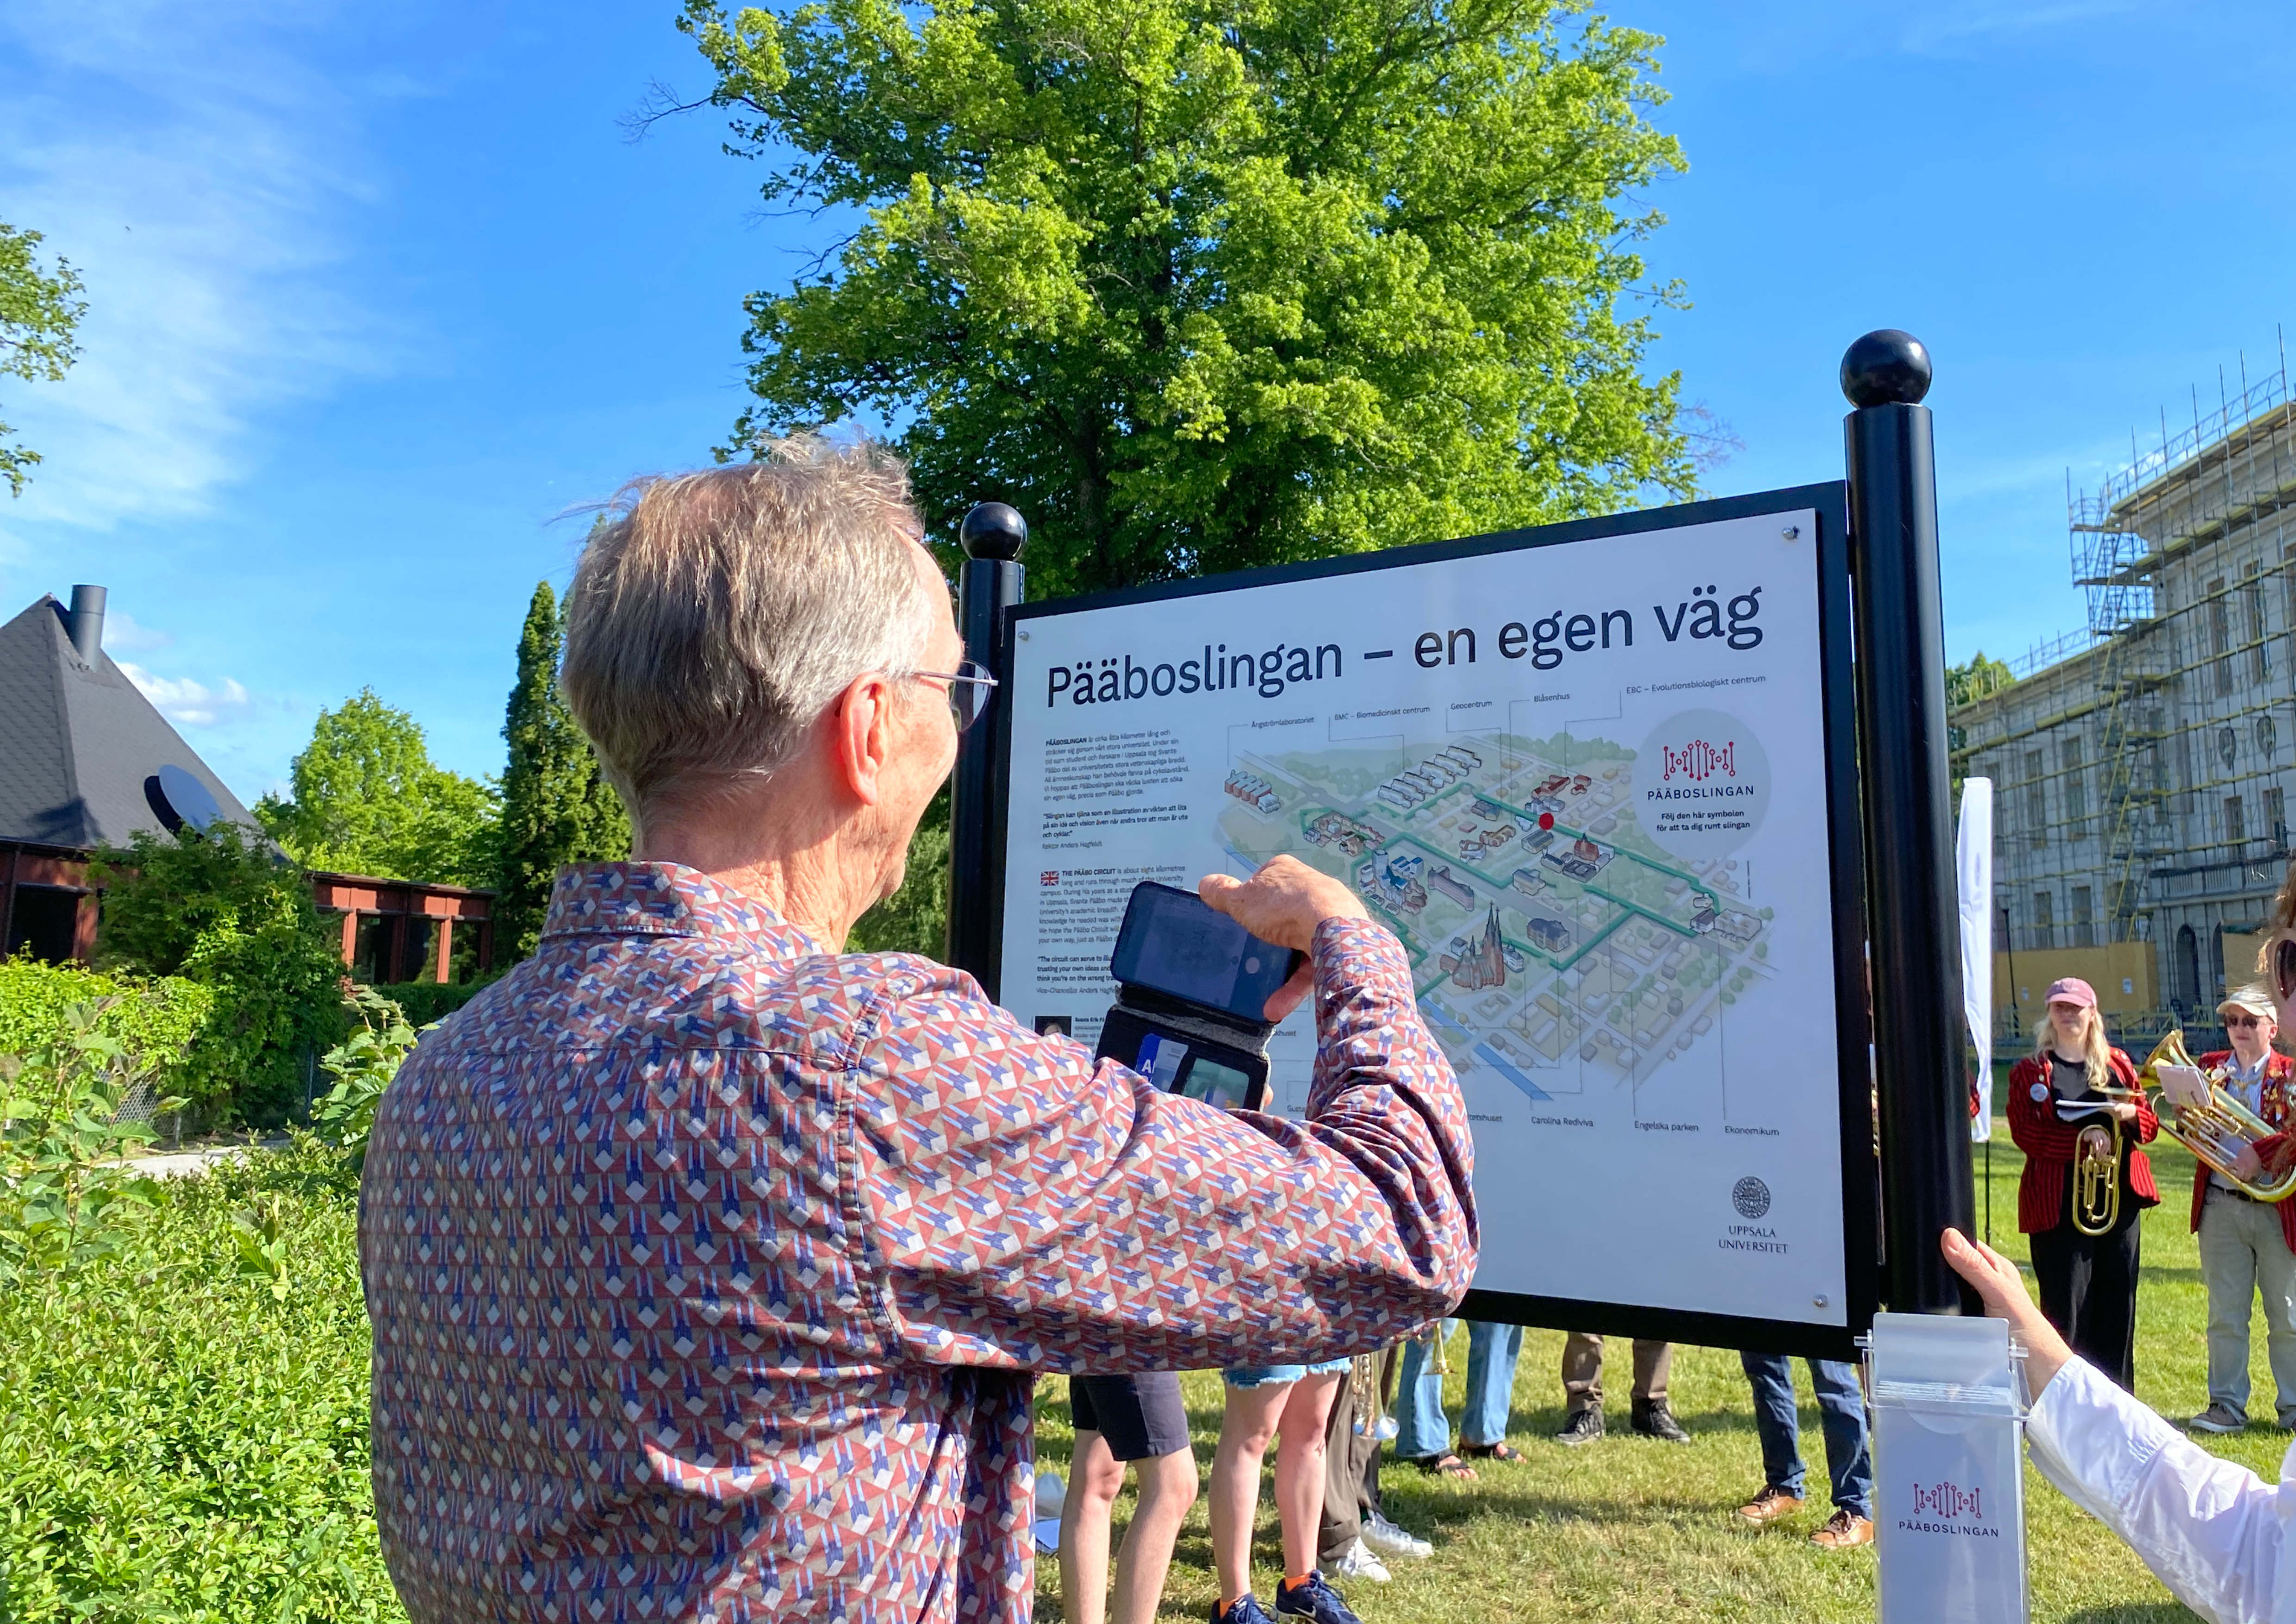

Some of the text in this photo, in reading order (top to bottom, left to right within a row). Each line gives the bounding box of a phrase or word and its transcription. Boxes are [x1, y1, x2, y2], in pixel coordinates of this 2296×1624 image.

[1048, 643, 1342, 708] Pääboslingan
[1414, 628, 1476, 668] en
[1499, 610, 1633, 670] egen
[1653, 585, 1763, 650] väg
[1626, 686, 1642, 694] EBC
[1651, 678, 1730, 692] Evolutionsbiologiskt
[1731, 676, 1766, 685] centrum
[1534, 693, 1570, 702] Blåsenhus
[1450, 701, 1493, 710] Geocentrum
[1334, 712, 1349, 721] BMC
[1356, 708, 1401, 719] Biomedicinskt
[1251, 717, 1314, 730] Ångströmlaboratoriet
[1648, 785, 1754, 800] PÄÄBOSLINGAN
[1661, 812, 1675, 821] Följ
[1707, 810, 1744, 820] symbolen
[1691, 823, 1703, 832] dig
[1723, 821, 1750, 830] slingan
[1468, 1114, 1502, 1122] tetshuset
[1531, 1116, 1594, 1127] Carolina Rediviva
[1634, 1120, 1699, 1132] Engelska parken
[1724, 1125, 1780, 1136] Ekonomikum
[1729, 1225, 1776, 1238] UPPSALA
[1718, 1239, 1788, 1254] UNIVERSITET
[1899, 1519, 1998, 1537] PÄÄBOSLINGAN
